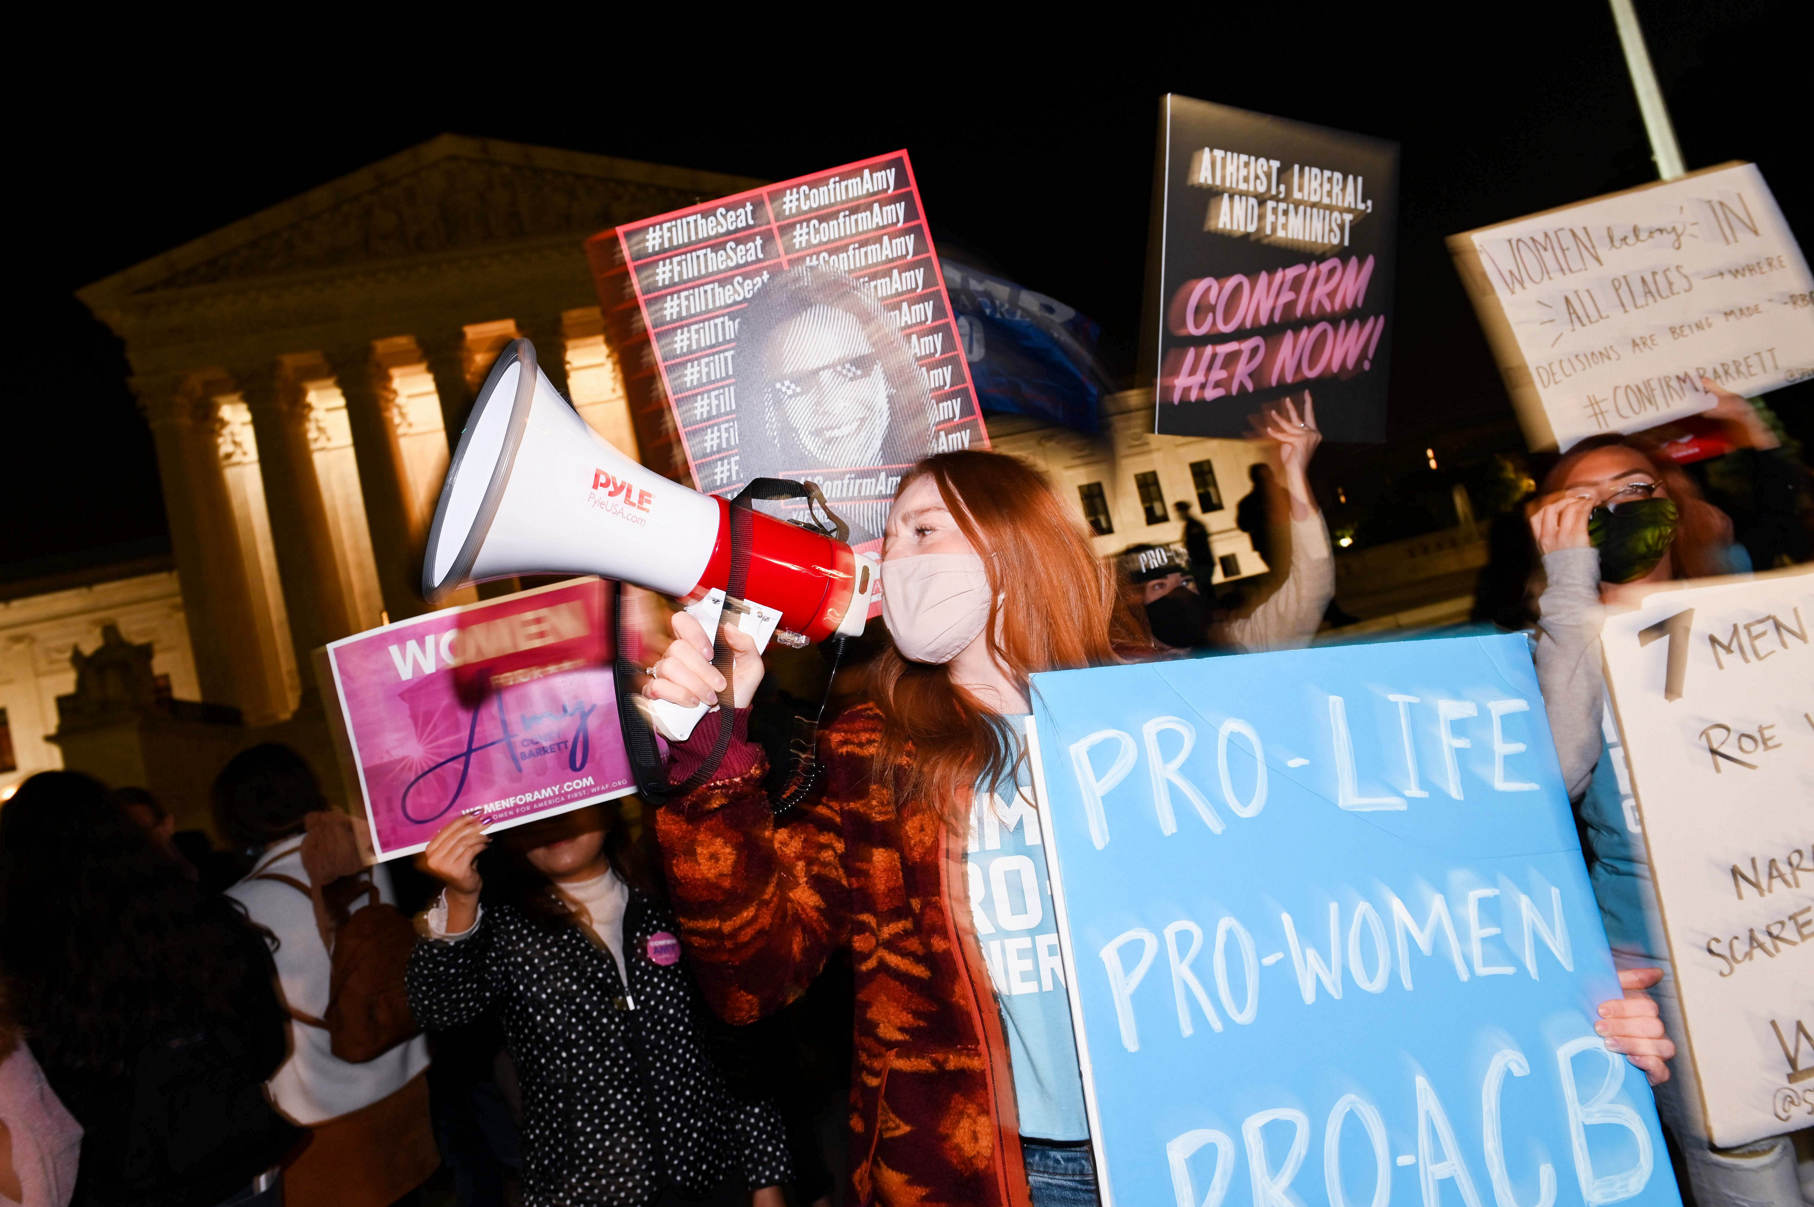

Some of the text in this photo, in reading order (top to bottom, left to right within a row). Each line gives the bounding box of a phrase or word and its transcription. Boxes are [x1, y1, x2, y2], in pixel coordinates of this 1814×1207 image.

[782, 167, 896, 215] #ConfirmAmy
[1200, 147, 1373, 213] ATHEIST, LIBERAL,
[645, 202, 754, 252] #FillTheSeat
[792, 201, 906, 249] #ConfirmAmy
[1218, 193, 1354, 247] AND FEMINIST
[1479, 192, 1761, 296] WOMEN belong IN
[655, 235, 764, 287] #FillTheSeat
[1563, 254, 1787, 332] ALL PLACES WHERE
[1186, 254, 1376, 337] CONFIRM
[1173, 314, 1385, 406] HER NOW!
[1536, 345, 1621, 390] DECISIONS
[1631, 334, 1659, 354] ARE
[1669, 316, 1713, 340] BEING
[1723, 303, 1762, 321] MADE
[1583, 347, 1781, 430] #CONFIRMBARRETT
[587, 491, 647, 528] PyleUSA.com
[389, 600, 592, 680] WOMEN
[1708, 606, 1810, 671] MEN
[520, 740, 569, 761] BARRETT
[1699, 722, 1783, 773] ROE
[493, 811, 514, 820] OMEN
[516, 806, 531, 815] FOR
[533, 797, 566, 809] AMERICA
[1731, 847, 1814, 900] NAR
[1100, 887, 1574, 1052] PRO-WOMEN
[1166, 1035, 1654, 1207] PRO-ACB
